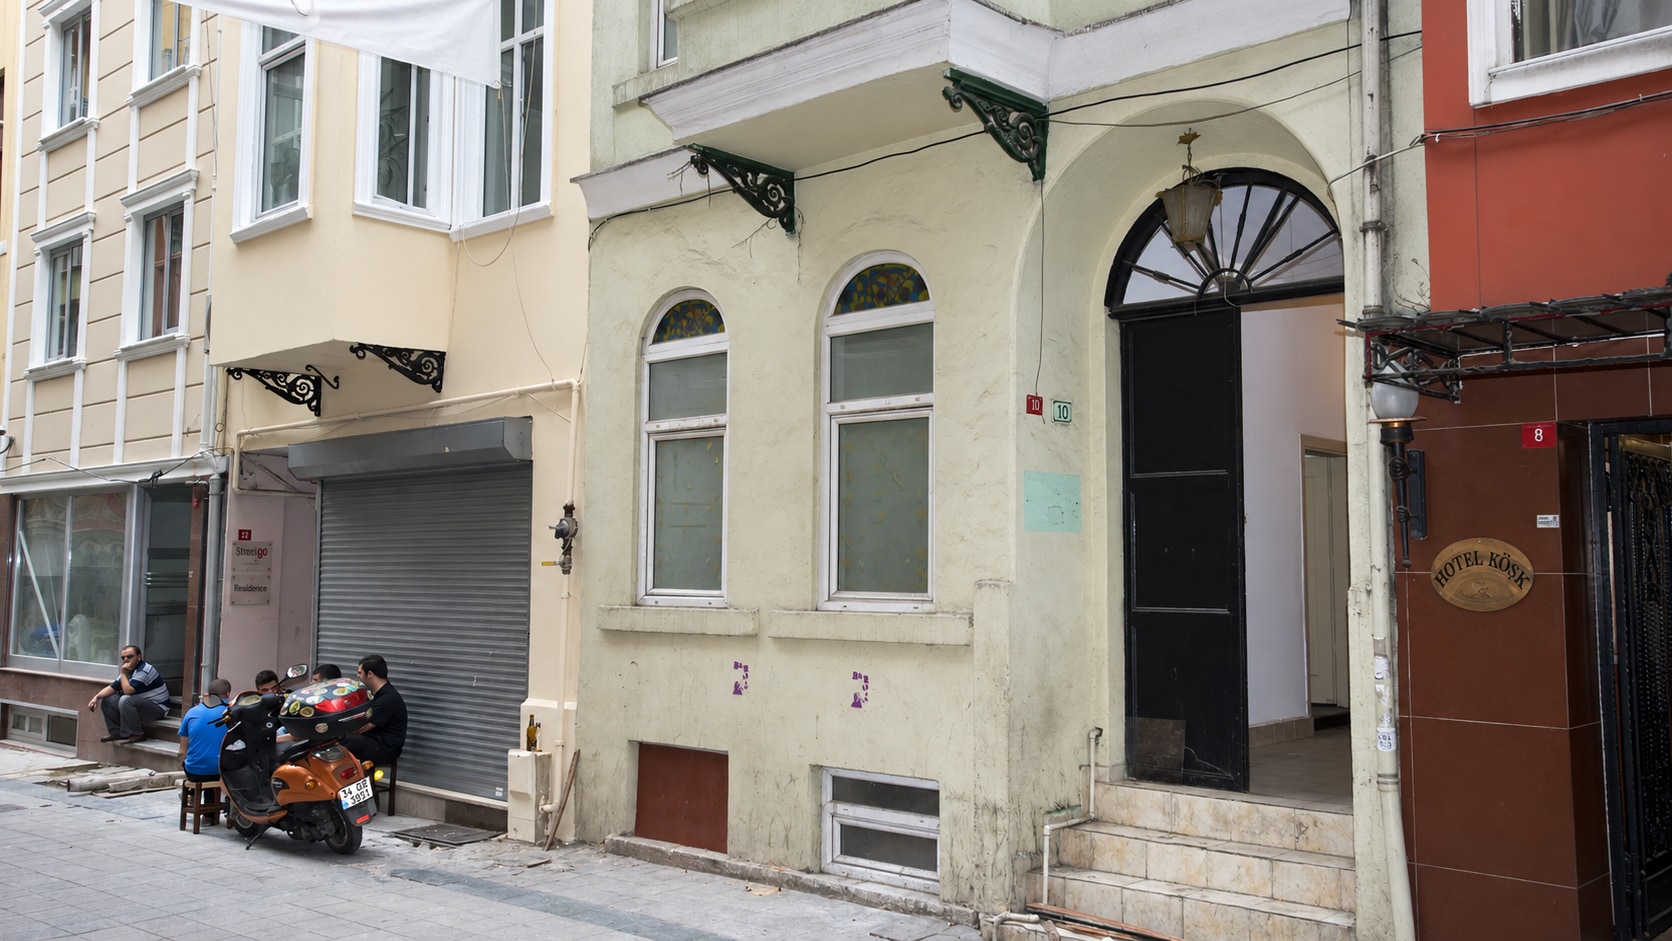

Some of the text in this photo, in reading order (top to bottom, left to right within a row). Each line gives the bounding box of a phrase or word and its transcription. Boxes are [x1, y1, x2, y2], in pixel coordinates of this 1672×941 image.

[1032, 399, 1040, 411] 10
[1057, 404, 1069, 420] 10
[1534, 428, 1544, 442] 8
[1434, 550, 1530, 590] HOTEL KÖŞK
[233, 584, 268, 592] Residence
[341, 788, 353, 799] 34
